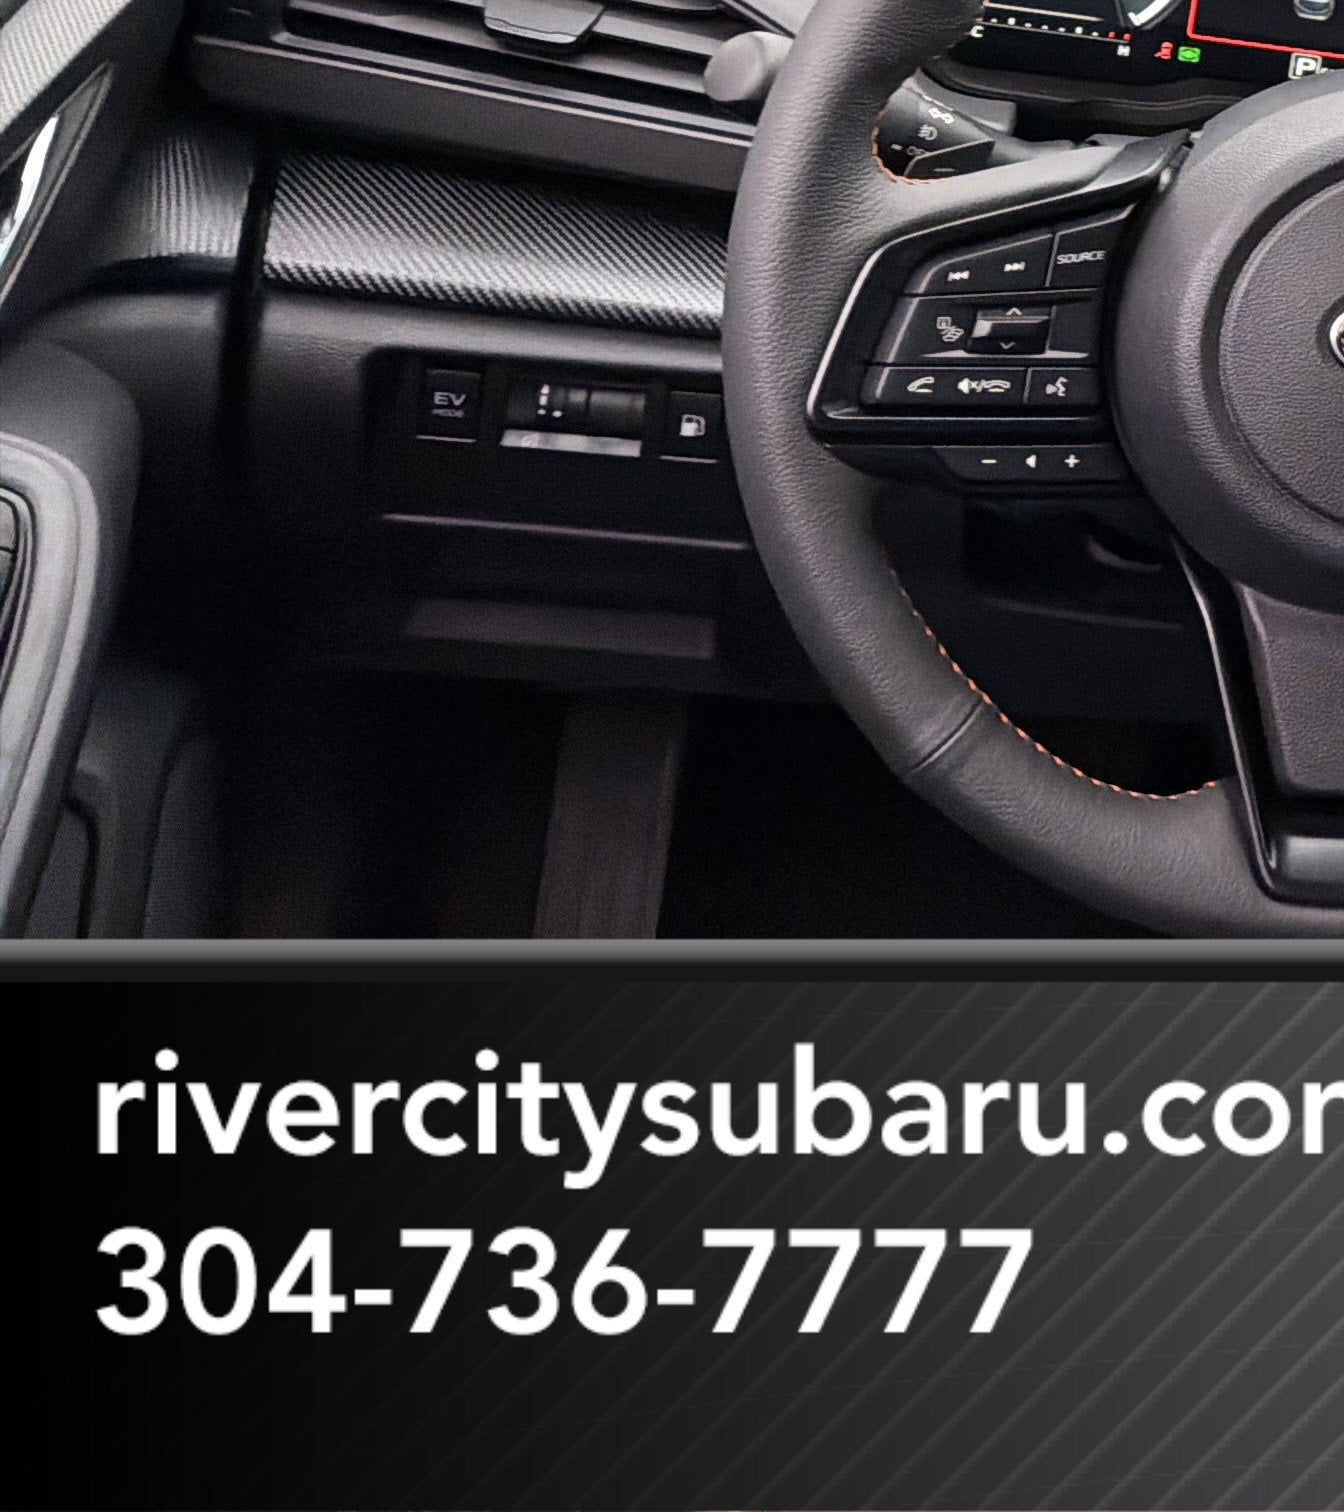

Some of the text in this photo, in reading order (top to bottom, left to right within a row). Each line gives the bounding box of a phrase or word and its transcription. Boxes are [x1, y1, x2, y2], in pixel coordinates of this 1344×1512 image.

[1117, 45, 1130, 57] H
[1295, 57, 1317, 76] P
[1056, 250, 1107, 265] SOURCE
[432, 391, 466, 407] EV
